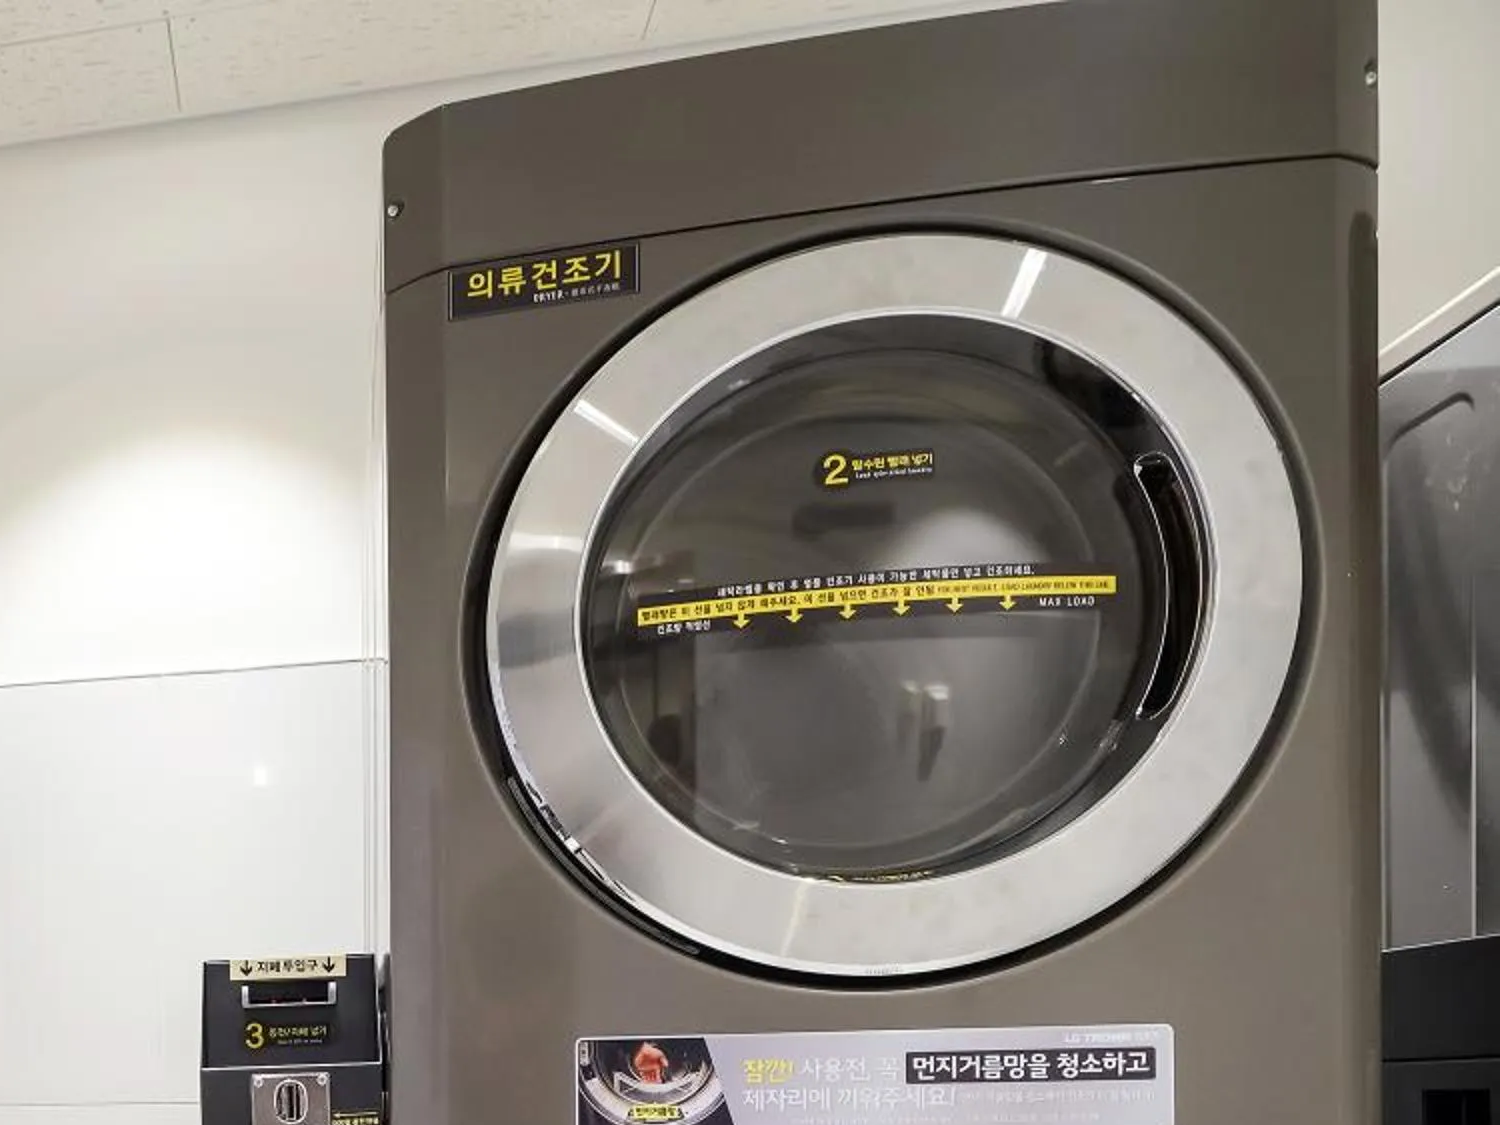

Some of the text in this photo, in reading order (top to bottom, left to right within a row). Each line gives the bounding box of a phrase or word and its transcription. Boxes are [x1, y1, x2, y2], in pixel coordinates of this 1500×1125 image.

[467, 249, 622, 299] 의류건조기
[824, 453, 849, 485] 2
[1039, 596, 1095, 607] MAX LOAD
[245, 1023, 264, 1049] 3
[801, 1057, 871, 1082] 사용전
[912, 1053, 1050, 1080] 먼지거름망을
[1056, 1051, 1150, 1078] 청소하고
[742, 1087, 832, 1112] 제자리에
